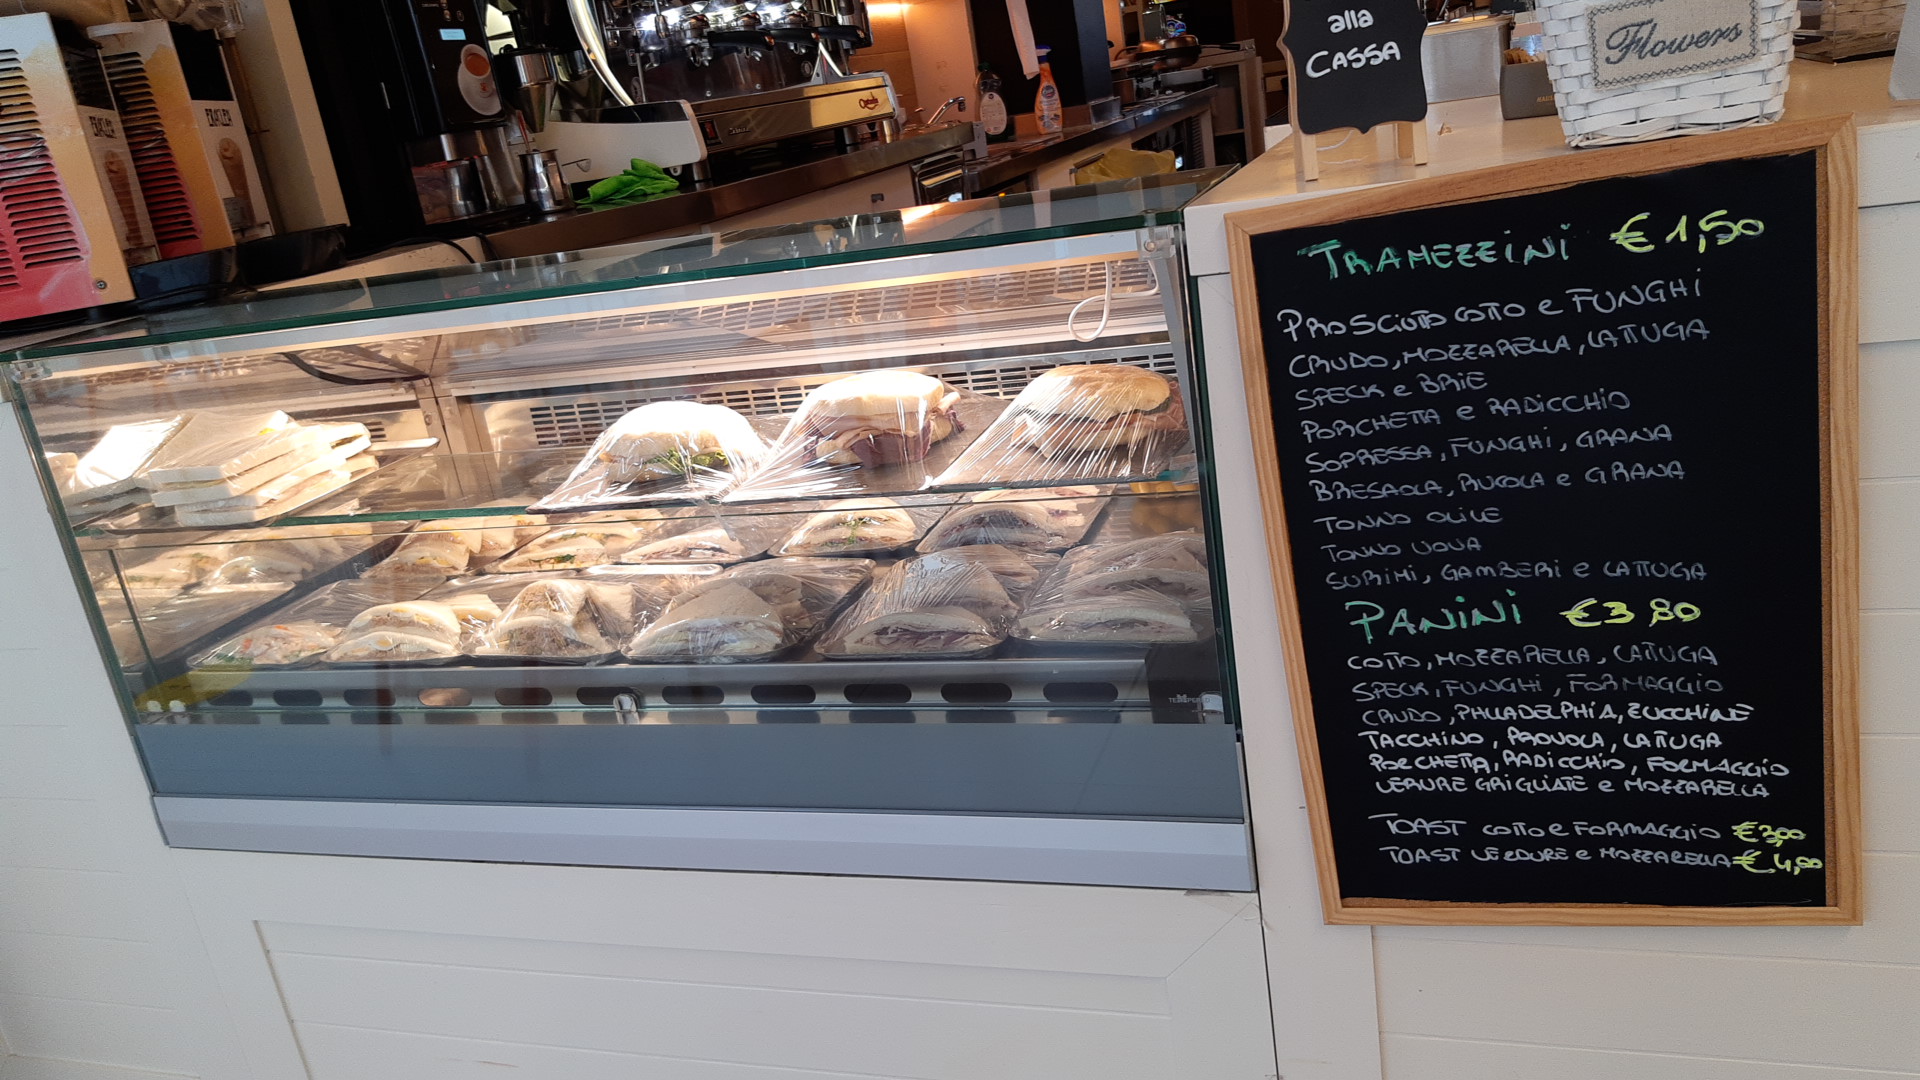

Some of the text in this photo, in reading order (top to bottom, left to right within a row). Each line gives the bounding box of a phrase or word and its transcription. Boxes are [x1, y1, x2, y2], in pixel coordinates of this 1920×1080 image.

[1327, 9, 1374, 33] alla
[1605, 18, 1743, 65] Flowers
[1305, 41, 1401, 78] CASSA
[1297, 223, 1571, 280] TRAMEZZINI
[1455, 302, 1526, 323] COTTO
[1538, 299, 1563, 315] e
[1565, 268, 1701, 313] FUNGHI
[1587, 319, 1710, 348] LATTUGA
[1295, 371, 1488, 411] SPECK e BRIE
[1300, 388, 1630, 443] PORCHETTA e RADICCHIO
[1576, 424, 1672, 448] GRANA
[1458, 471, 1545, 491] RUCOLA
[1556, 473, 1572, 486] e
[1585, 460, 1685, 484] GRANA
[1313, 507, 1503, 534] TONNO OLIVE
[1321, 543, 1401, 563] TONNO
[1440, 559, 1562, 582] GAMBERI
[1573, 562, 1590, 578] e
[1345, 588, 1521, 644] PANINI
[1566, 673, 1723, 695] FORMAGGIO
[1627, 703, 1754, 722] ZUCCHINE
[1647, 757, 1789, 778] FORMAGGIO
[1598, 780, 1615, 792] e
[1624, 777, 1769, 797] MOZZARELLA
[1368, 813, 1467, 836] TOAST
[1482, 822, 1545, 837] COTTO
[1549, 823, 1569, 836] e
[1573, 821, 1721, 841] FORMAGGIO
[1379, 846, 1461, 864] TOAST
[1575, 849, 1592, 860] e
[1599, 847, 1731, 868] MOZZARELLA
